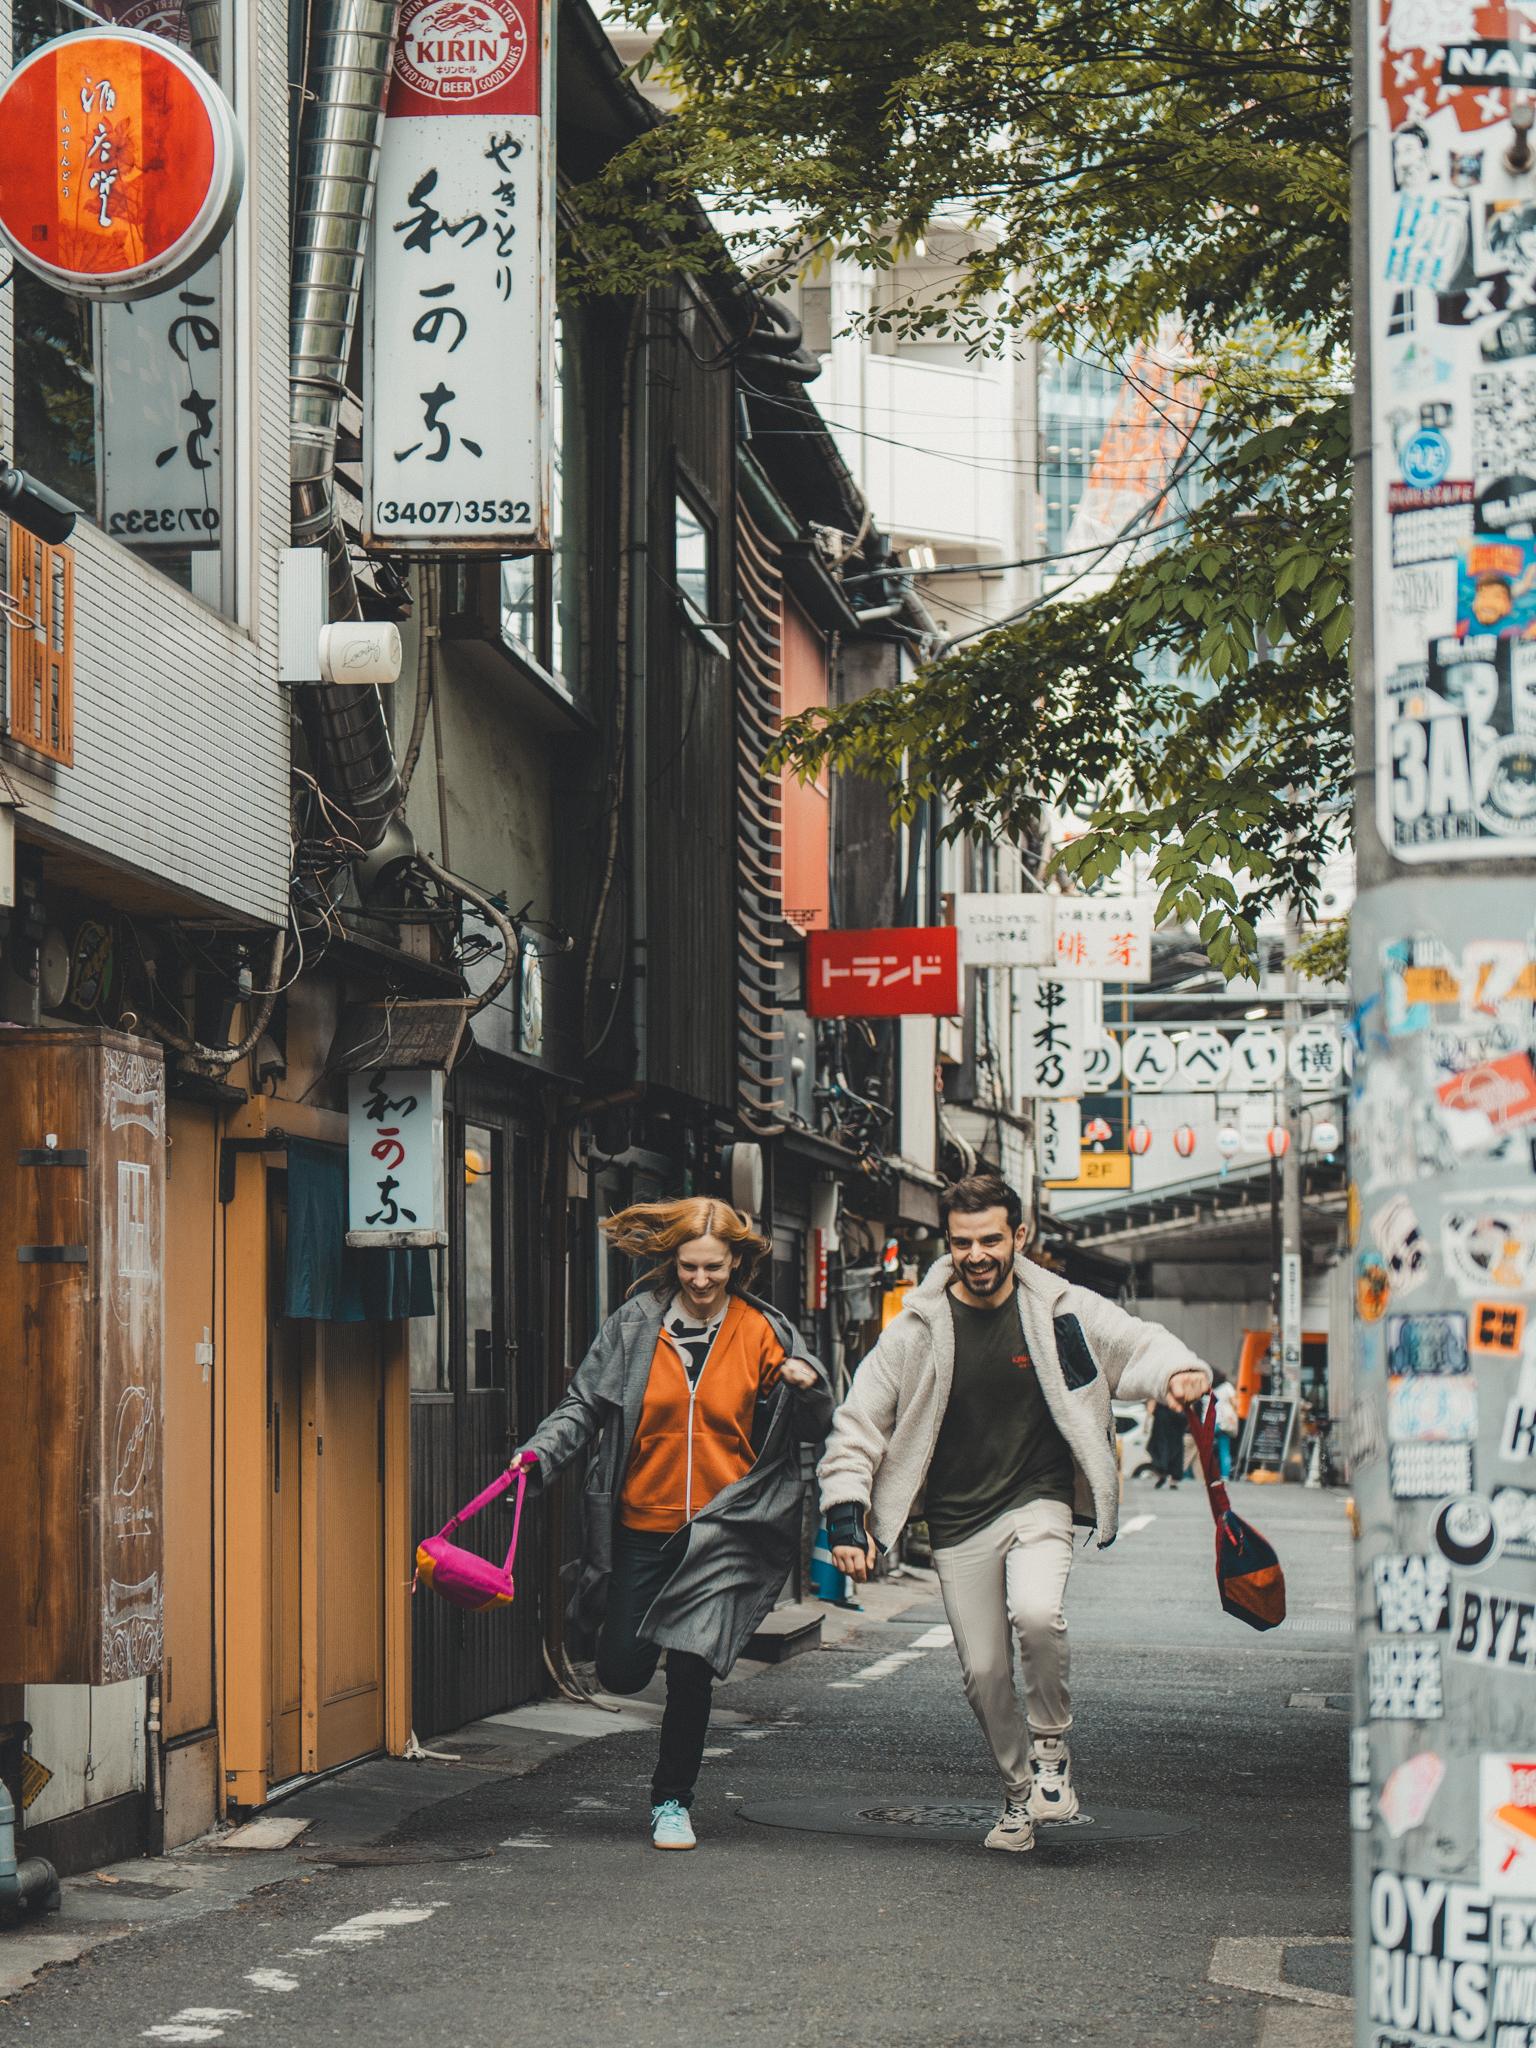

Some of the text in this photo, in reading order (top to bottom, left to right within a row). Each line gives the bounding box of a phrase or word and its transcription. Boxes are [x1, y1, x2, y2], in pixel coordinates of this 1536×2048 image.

[415, 77, 436, 92] FOR
[442, 81, 472, 93] BEER
[479, 71, 505, 90] GOOD
[505, 46, 522, 74] TIMES
[416, 40, 498, 63] KIRIN
[436, 66, 478, 74] キリンビール
[484, 131, 524, 302] やきとり
[376, 500, 531, 525] (3407)3532
[822, 955, 941, 988] トランド
[1370, 1870, 1490, 1964] OYE
[1368, 1944, 1490, 2043] RUNS
